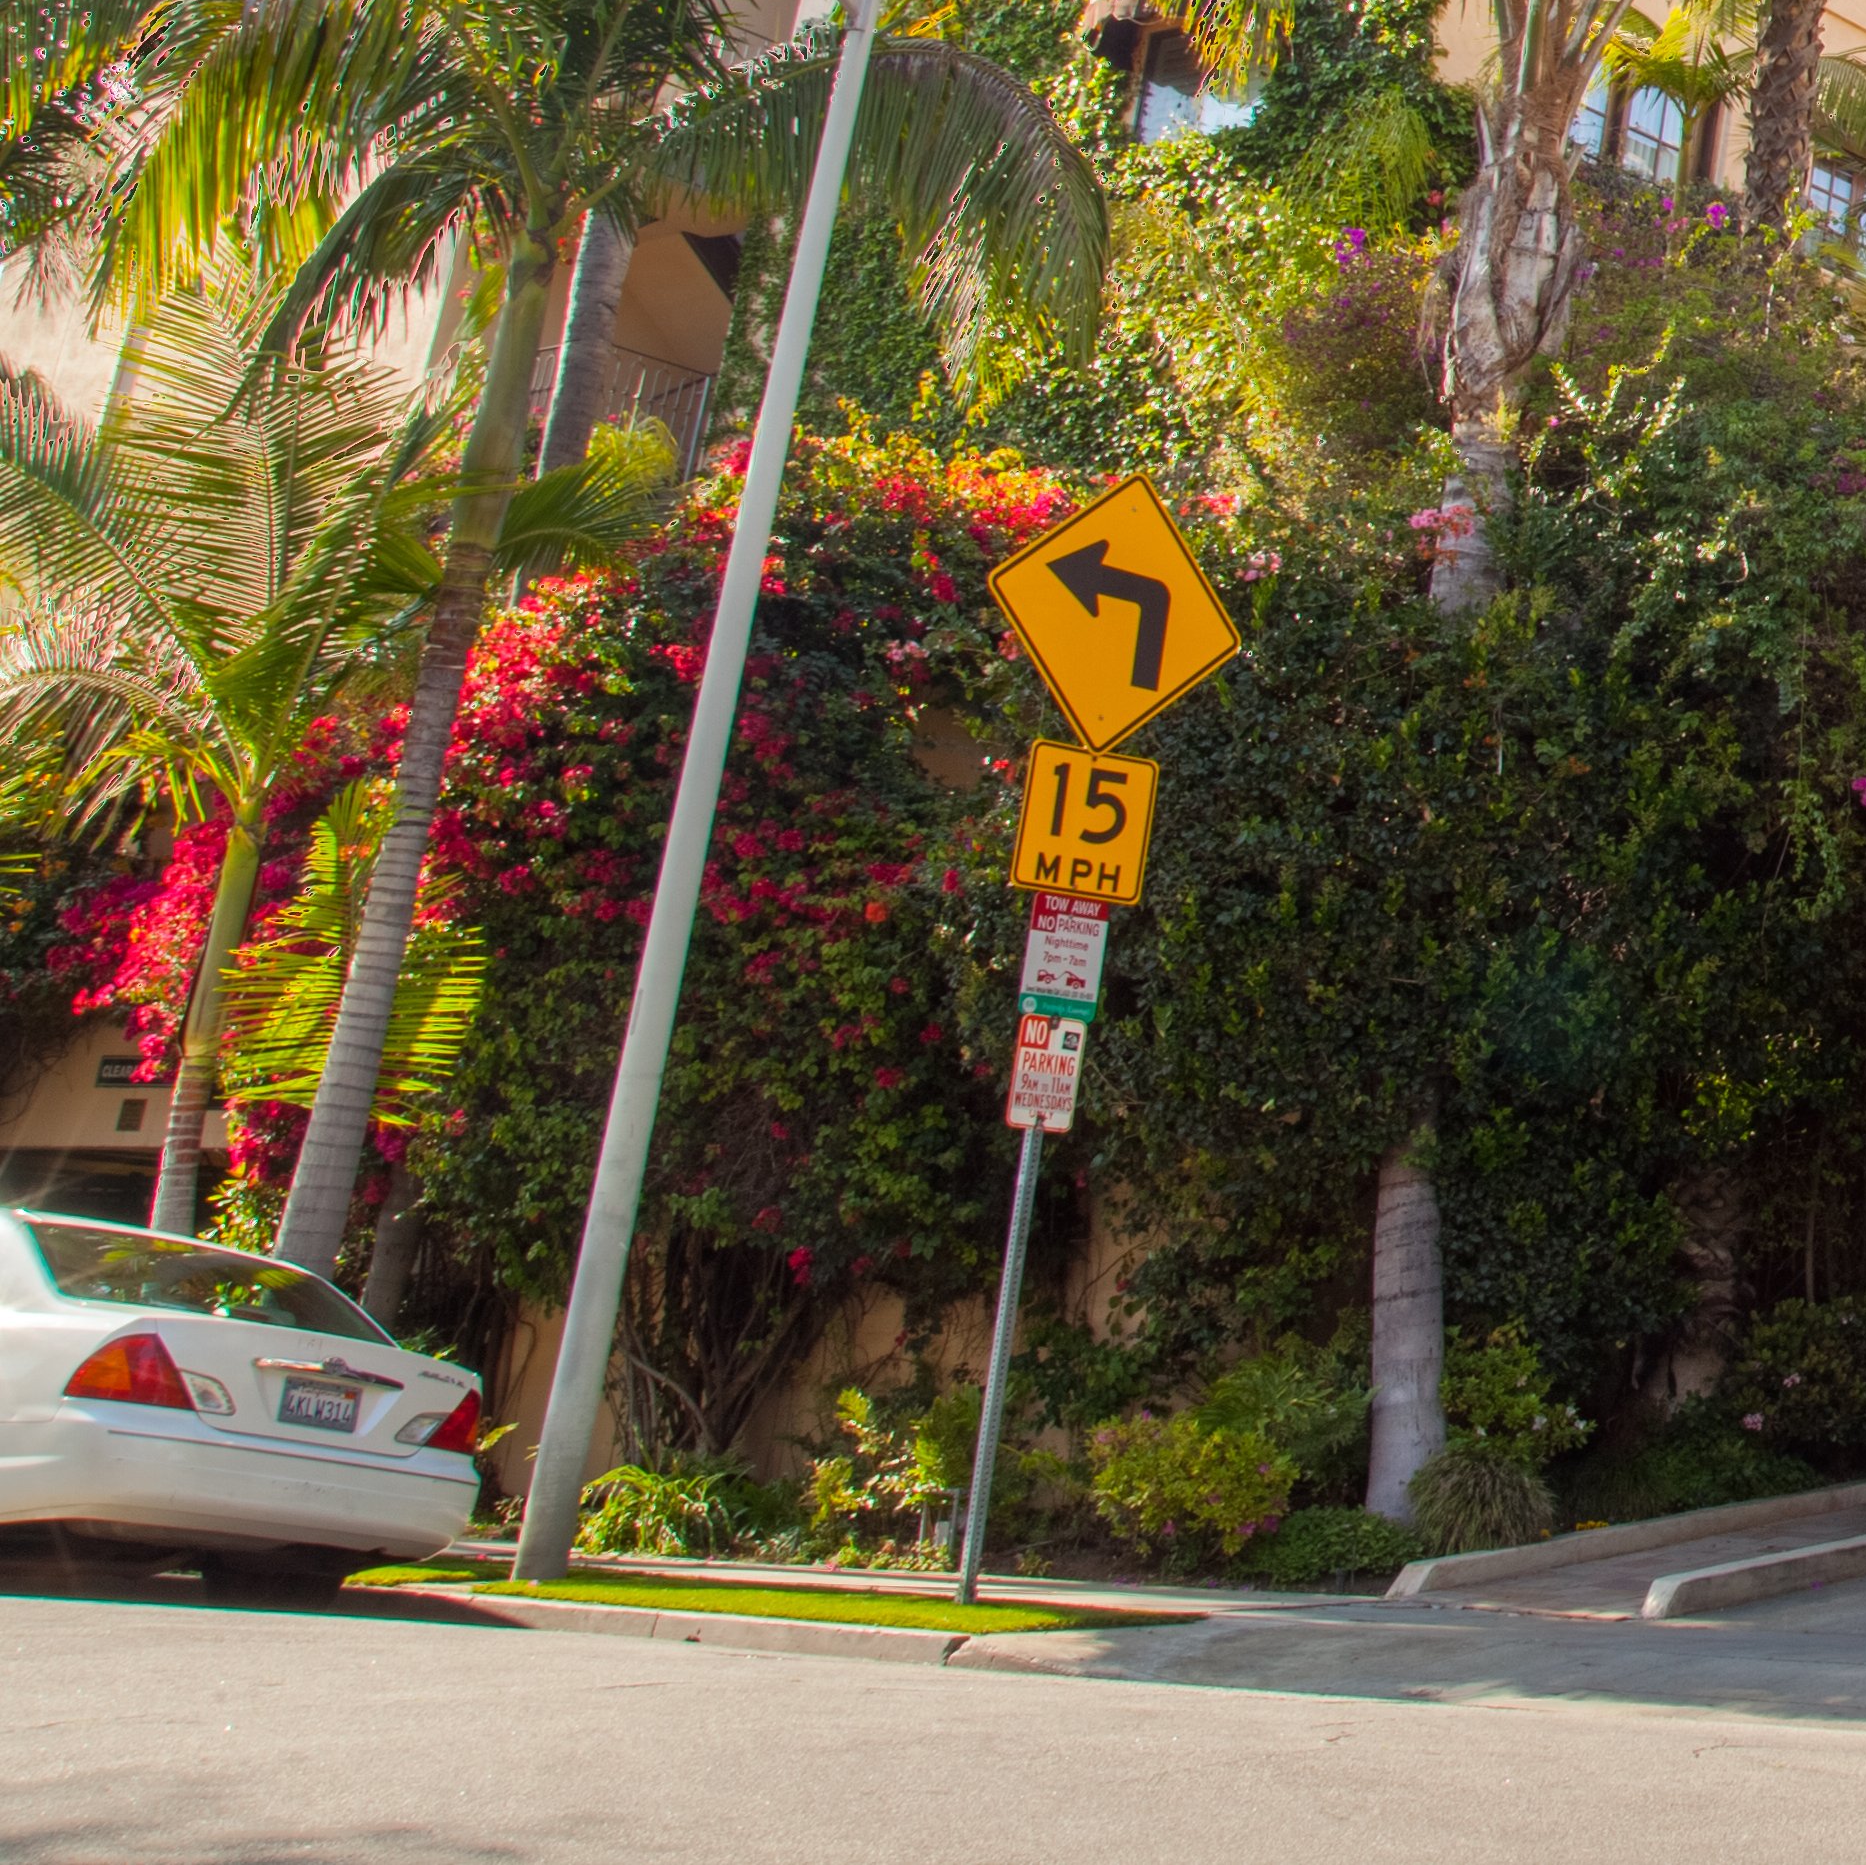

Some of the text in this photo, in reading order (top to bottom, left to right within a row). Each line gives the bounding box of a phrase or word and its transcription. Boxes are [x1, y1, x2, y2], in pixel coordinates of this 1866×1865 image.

[1050, 762, 1128, 844] 15
[1035, 852, 1121, 892] MPH
[1045, 895, 1101, 916] TOW AWAY
[1037, 914, 1100, 936] NO PARKING
[1044, 935, 1089, 951] Nighttime
[1024, 1019, 1048, 1045] NO
[1022, 1051, 1076, 1076] PARKING
[1021, 1073, 1039, 1092] 9AM
[1051, 1077, 1071, 1095] 11AM
[1014, 1092, 1073, 1112] WEDNESDAYS
